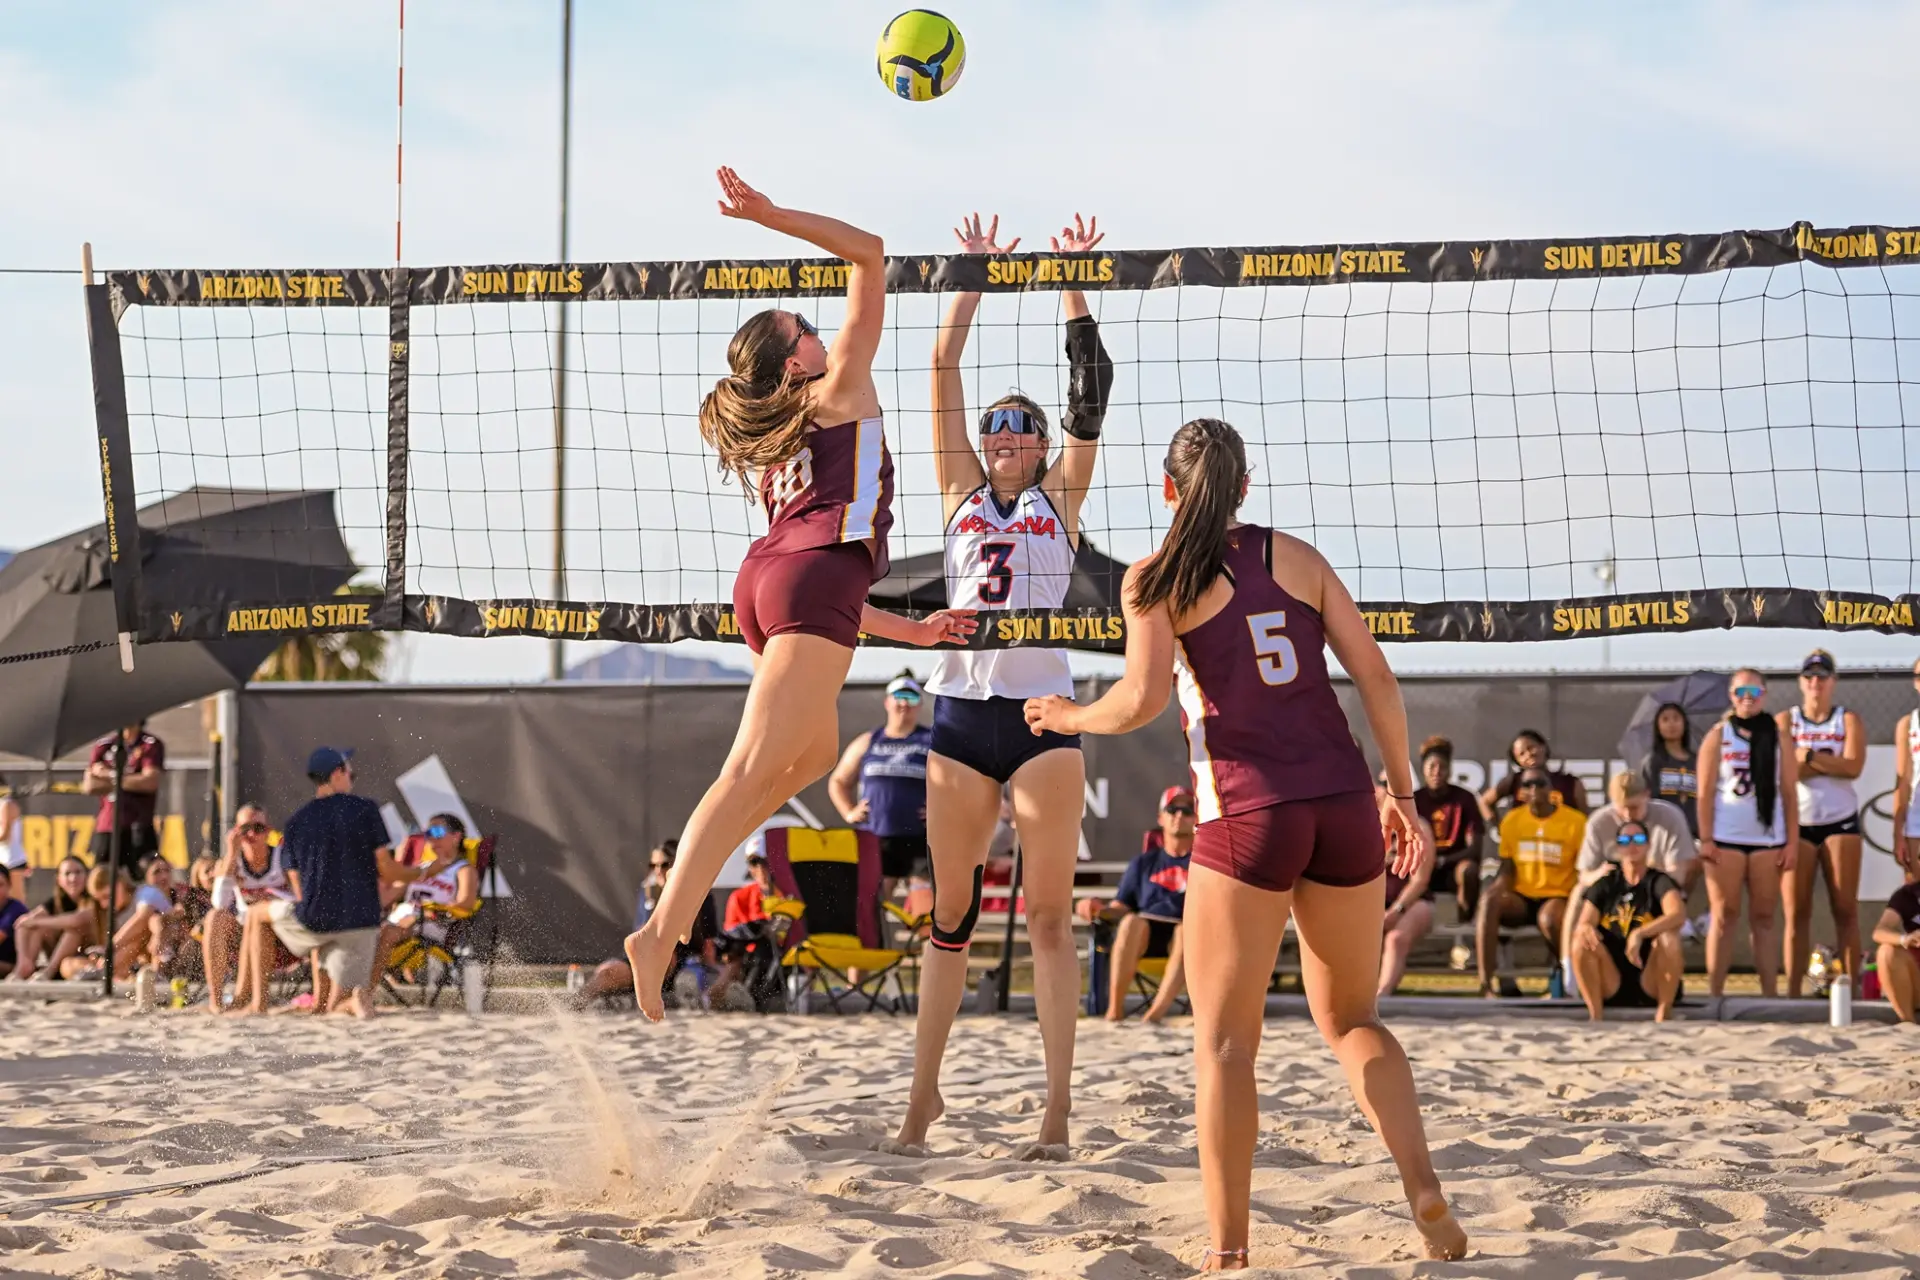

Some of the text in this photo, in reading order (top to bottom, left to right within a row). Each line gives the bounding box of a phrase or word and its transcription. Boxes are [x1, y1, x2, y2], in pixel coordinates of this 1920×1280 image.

[1242, 250, 1406, 277] ARIZONA STATE
[1544, 242, 1682, 271] SUN DEVILS
[463, 270, 583, 295] SUN DEVILS
[704, 266, 792, 290] ARIZONA
[987, 258, 1114, 284] SUN DEVILS
[201, 276, 345, 298] ARIZONA STATE
[977, 541, 1016, 606] 3
[227, 604, 371, 632] ARIZONA STATE
[485, 607, 600, 633] SUN DEVILS
[1553, 600, 1690, 632] SUN DEVILS
[1823, 600, 1914, 626] ARIZONA
[997, 616, 1122, 640] SUN DEVILS
[1245, 611, 1299, 686] 5
